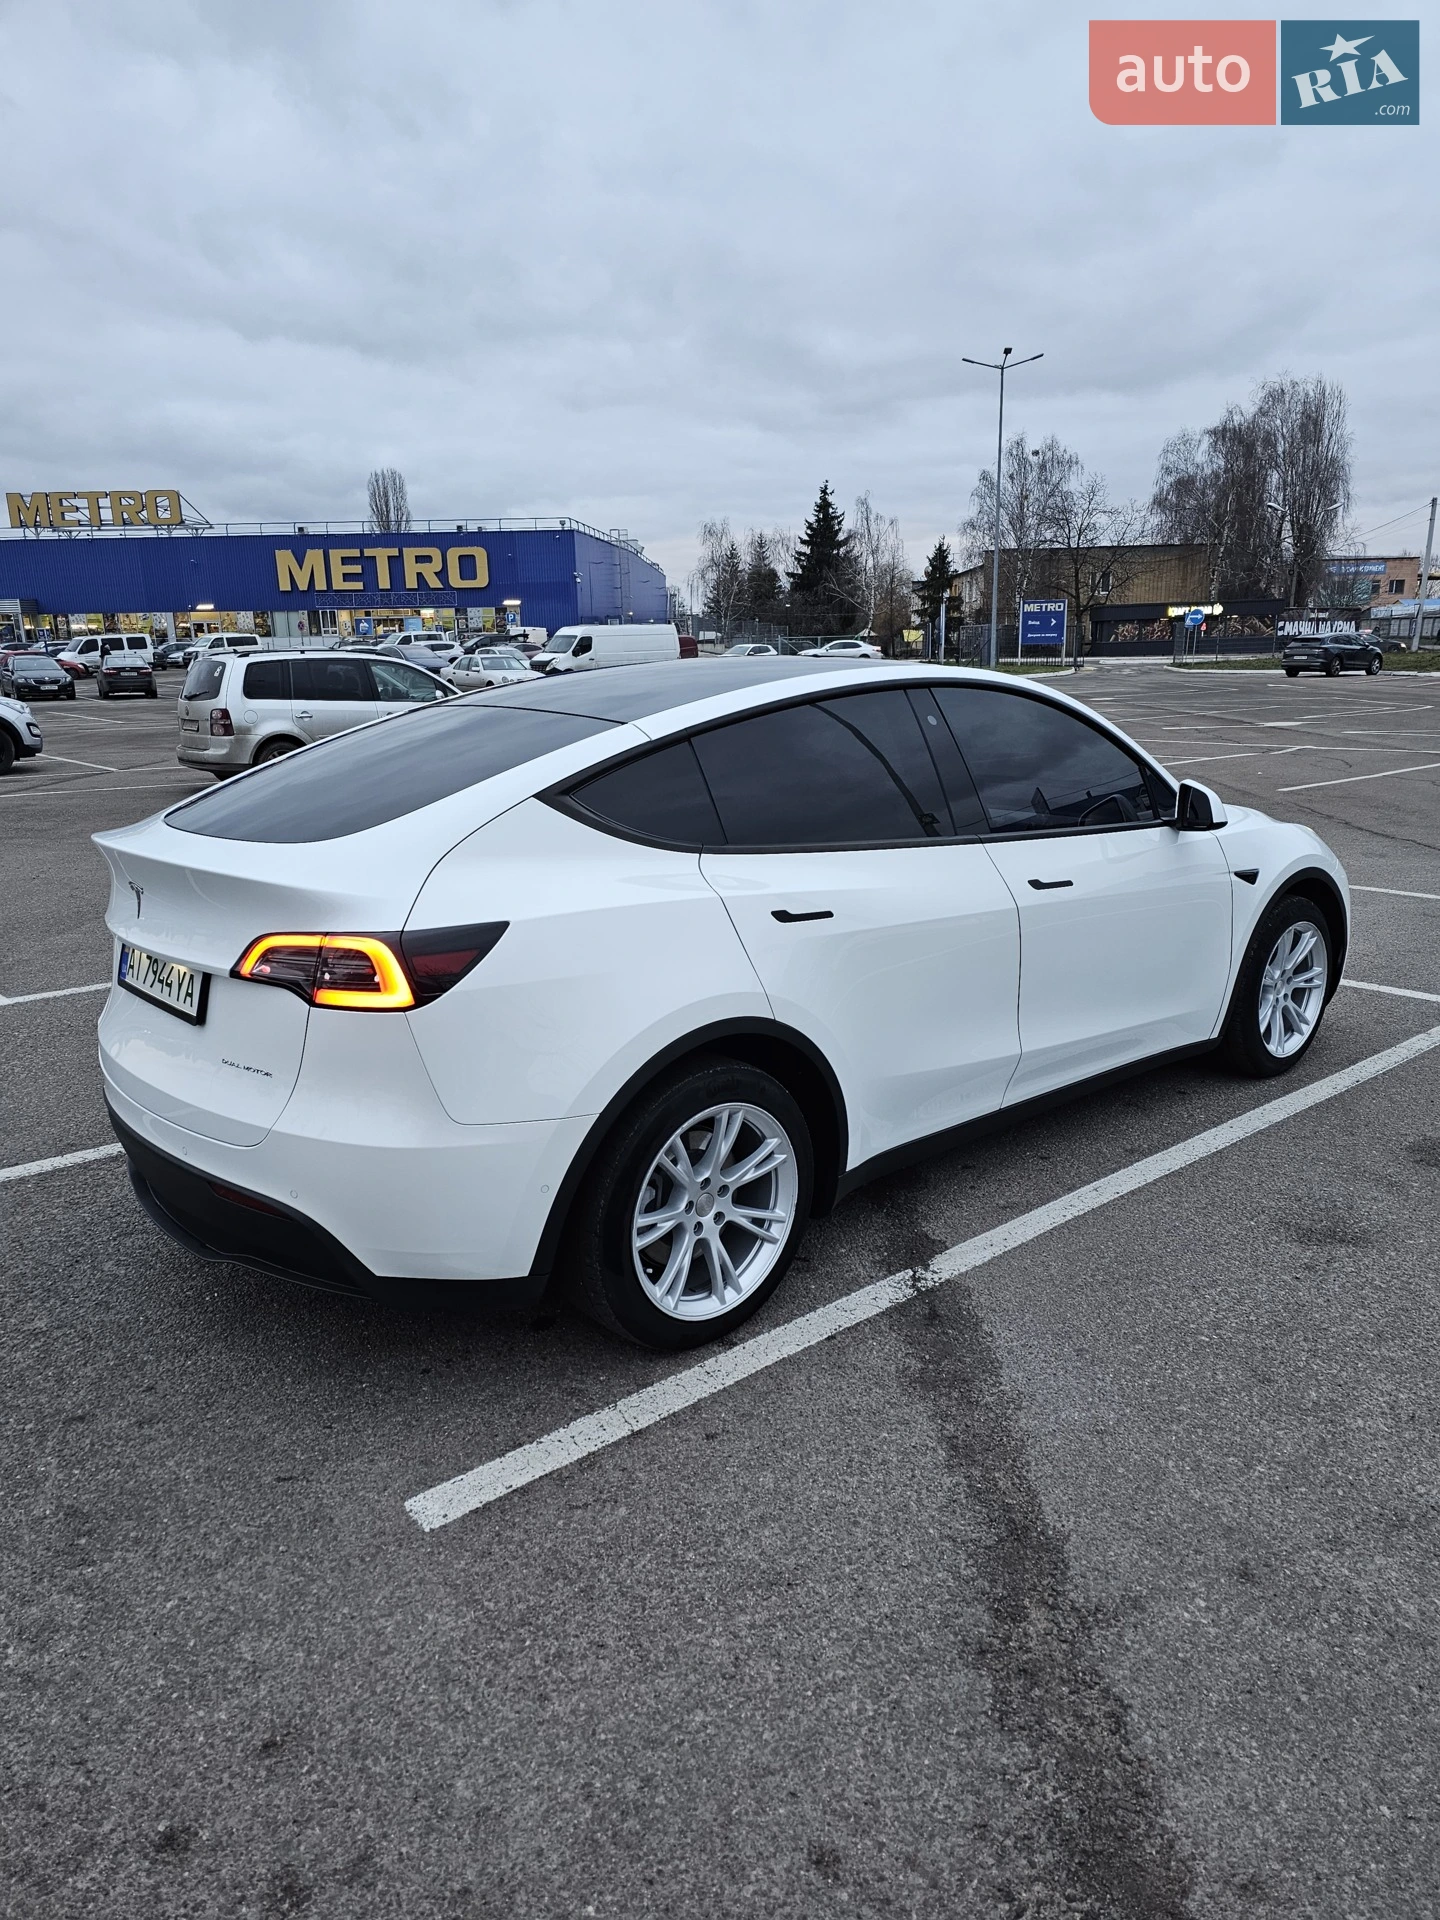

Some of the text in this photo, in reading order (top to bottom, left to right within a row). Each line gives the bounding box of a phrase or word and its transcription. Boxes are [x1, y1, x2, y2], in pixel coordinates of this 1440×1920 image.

[6, 490, 184, 528] METRO
[275, 547, 489, 591] METRO
[1024, 603, 1064, 612] METRO
